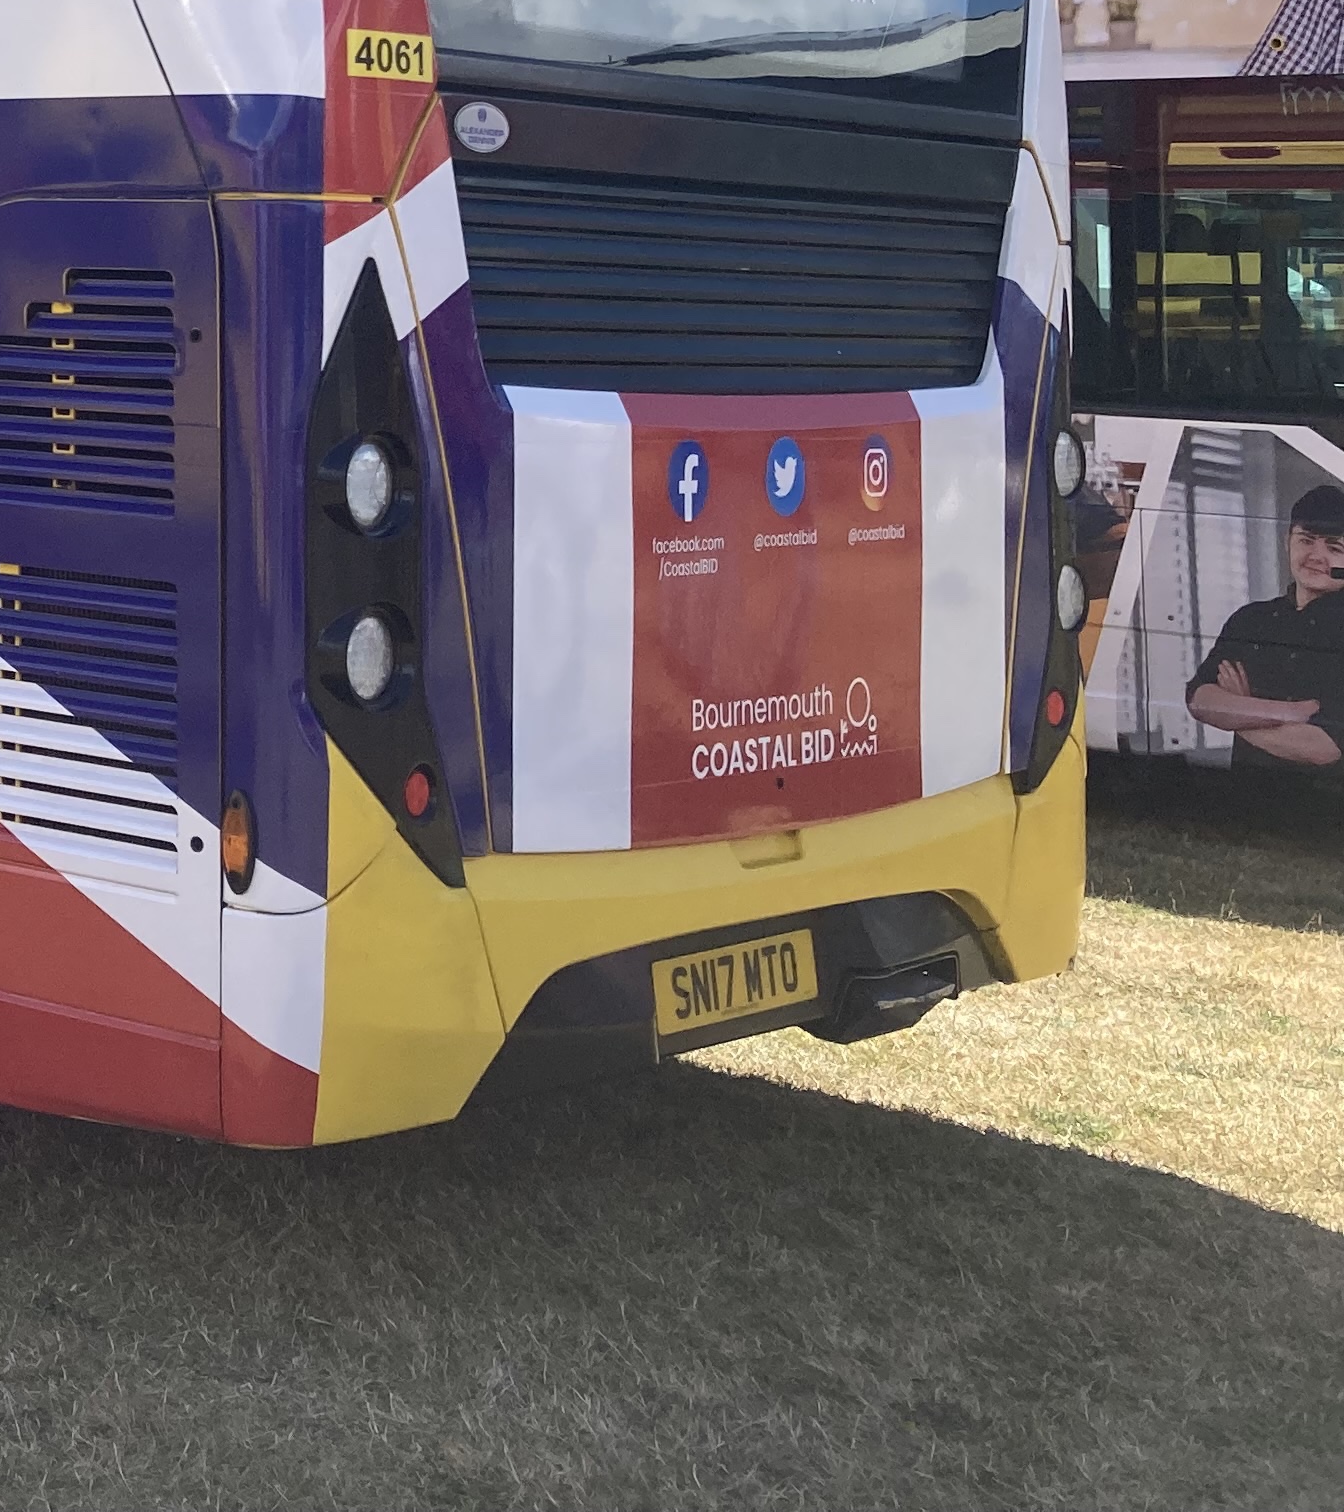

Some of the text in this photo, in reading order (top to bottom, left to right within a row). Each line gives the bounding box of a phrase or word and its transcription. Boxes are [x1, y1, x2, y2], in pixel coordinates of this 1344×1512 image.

[355, 37, 424, 76] 4061
[652, 534, 725, 555] facebook.com
[753, 529, 818, 552] @coastalbid
[847, 524, 905, 546] @coastalbid
[658, 557, 719, 581] /CoastalBID
[692, 682, 833, 731] Bournemouth
[691, 728, 835, 779] COASTAL BID
[671, 941, 799, 1020] SN17 MTO
